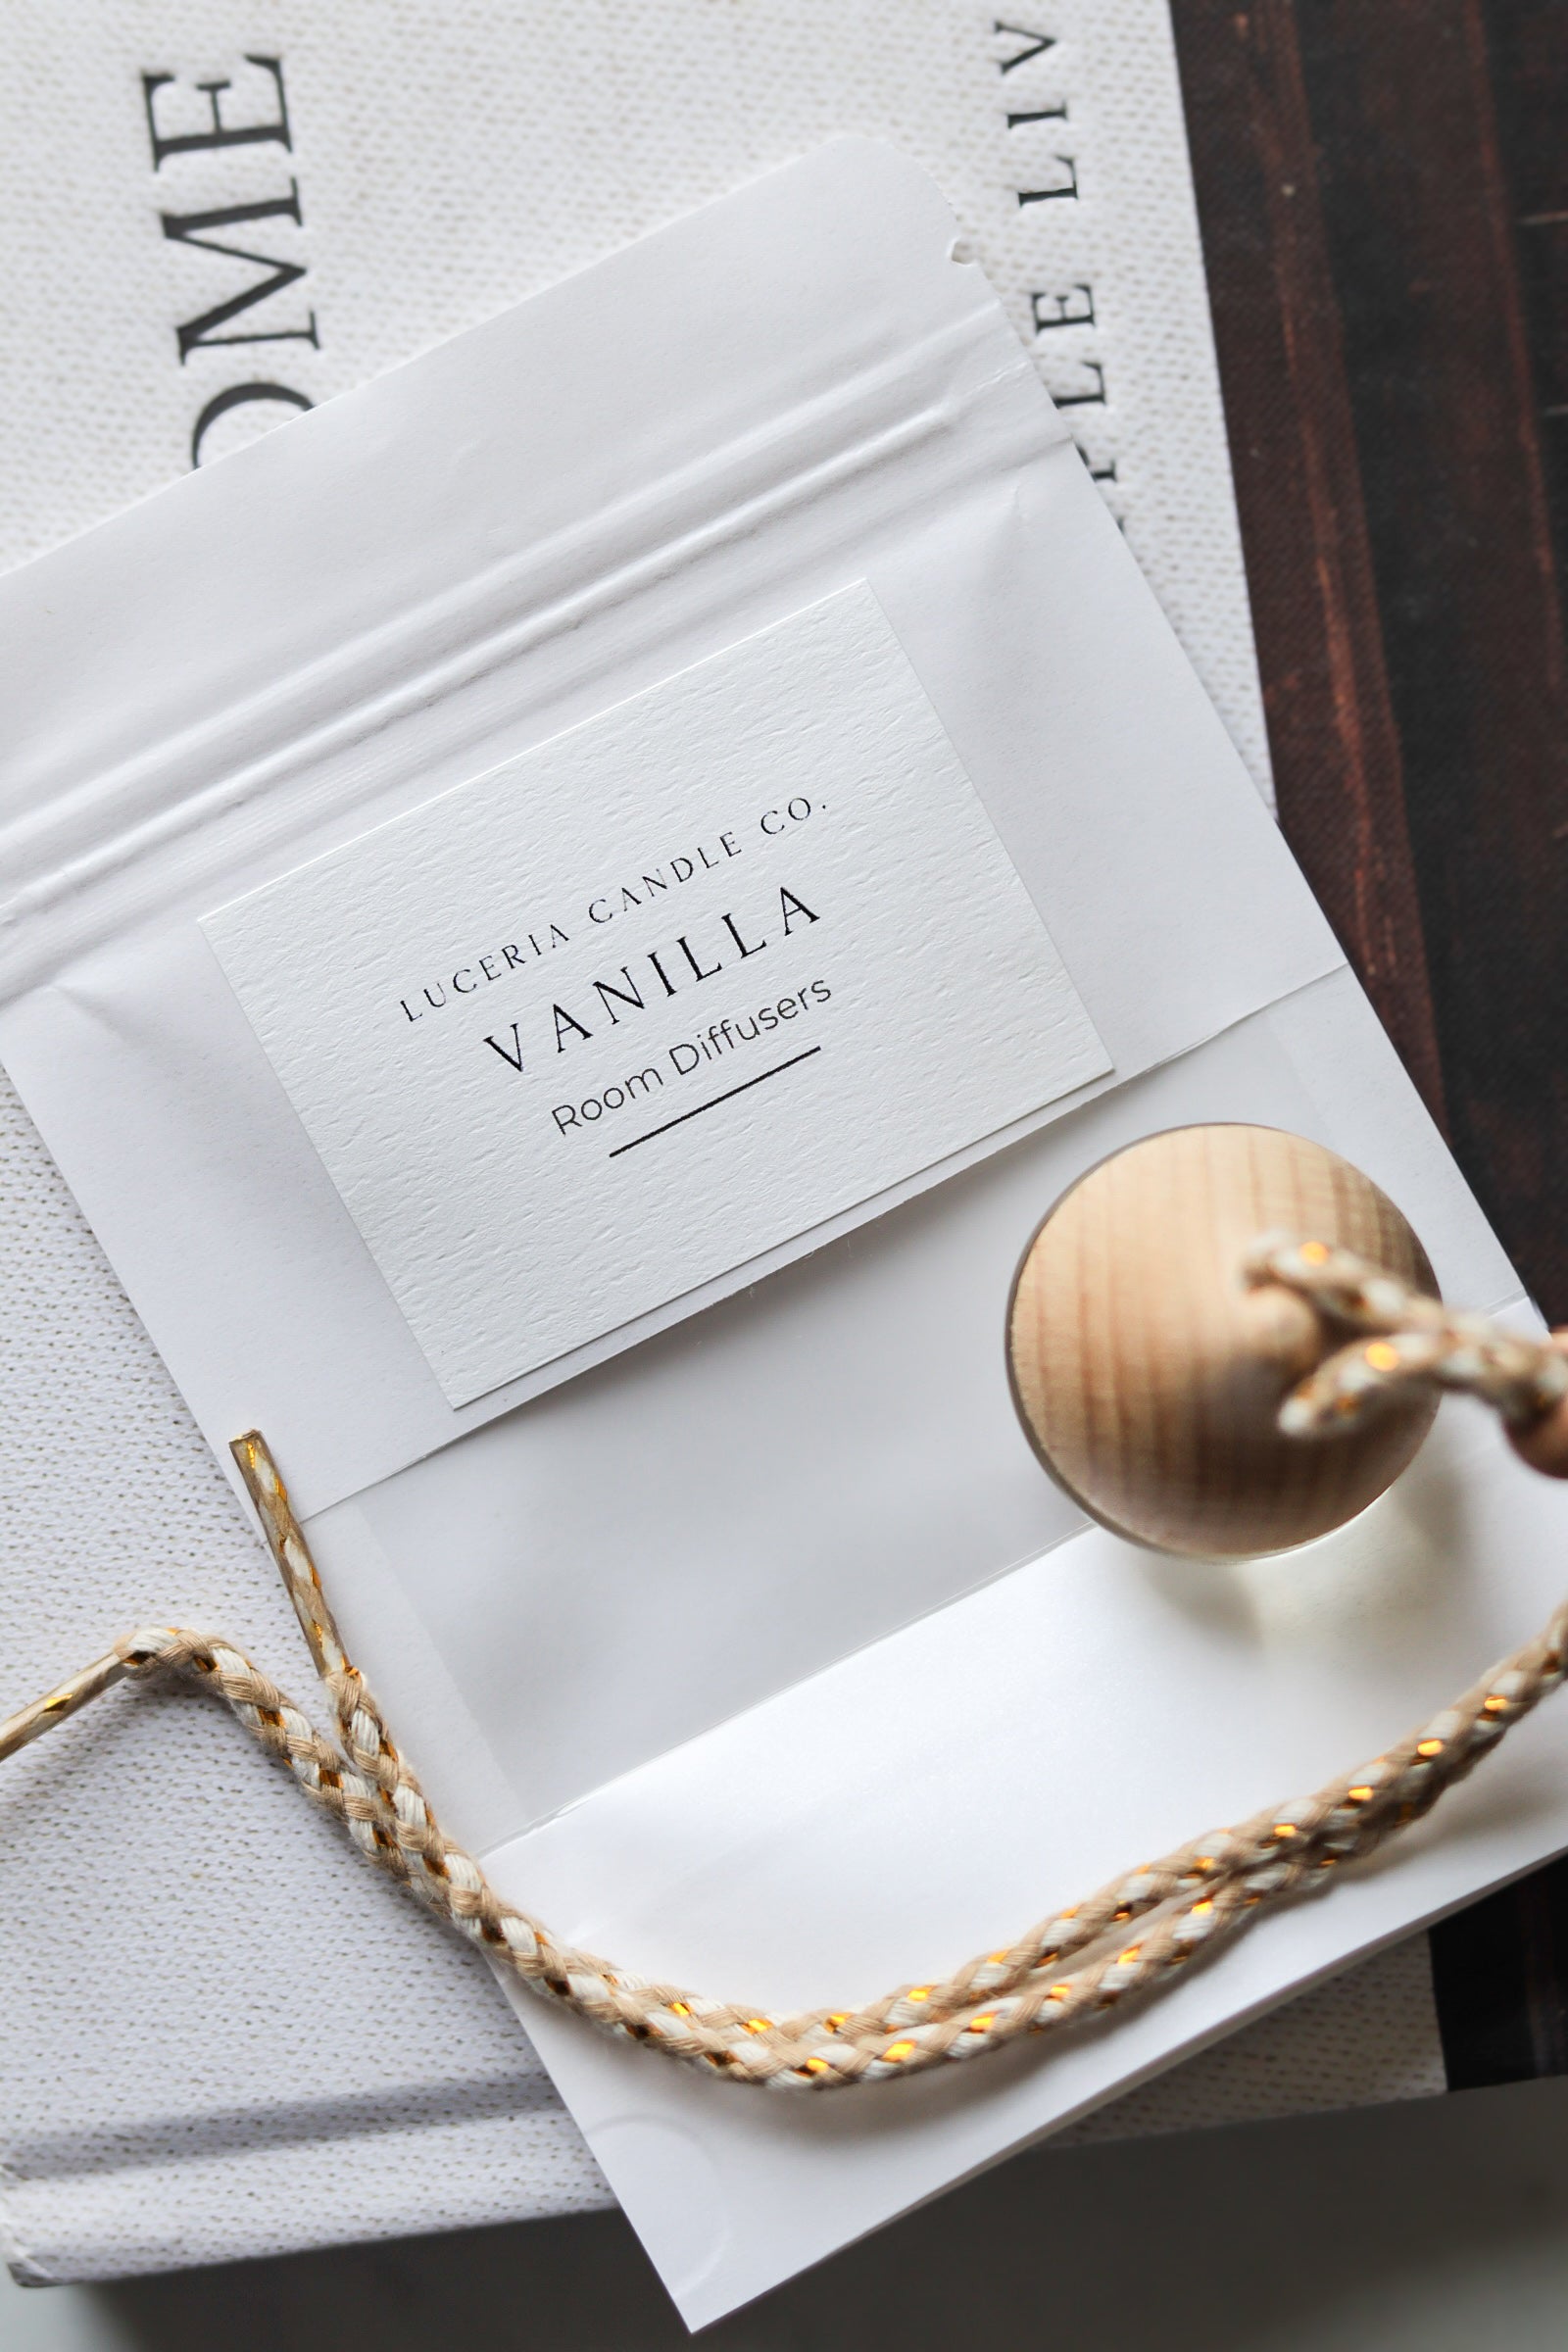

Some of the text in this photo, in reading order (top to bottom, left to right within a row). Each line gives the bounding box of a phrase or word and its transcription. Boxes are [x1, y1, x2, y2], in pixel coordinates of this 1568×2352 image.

[994, 21, 1079, 208] LIV
[399, 797, 827, 1023] LUCERIA CANDLE CO.
[482, 886, 821, 1073] VANILLA
[551, 979, 832, 1136] Room Diffusers
